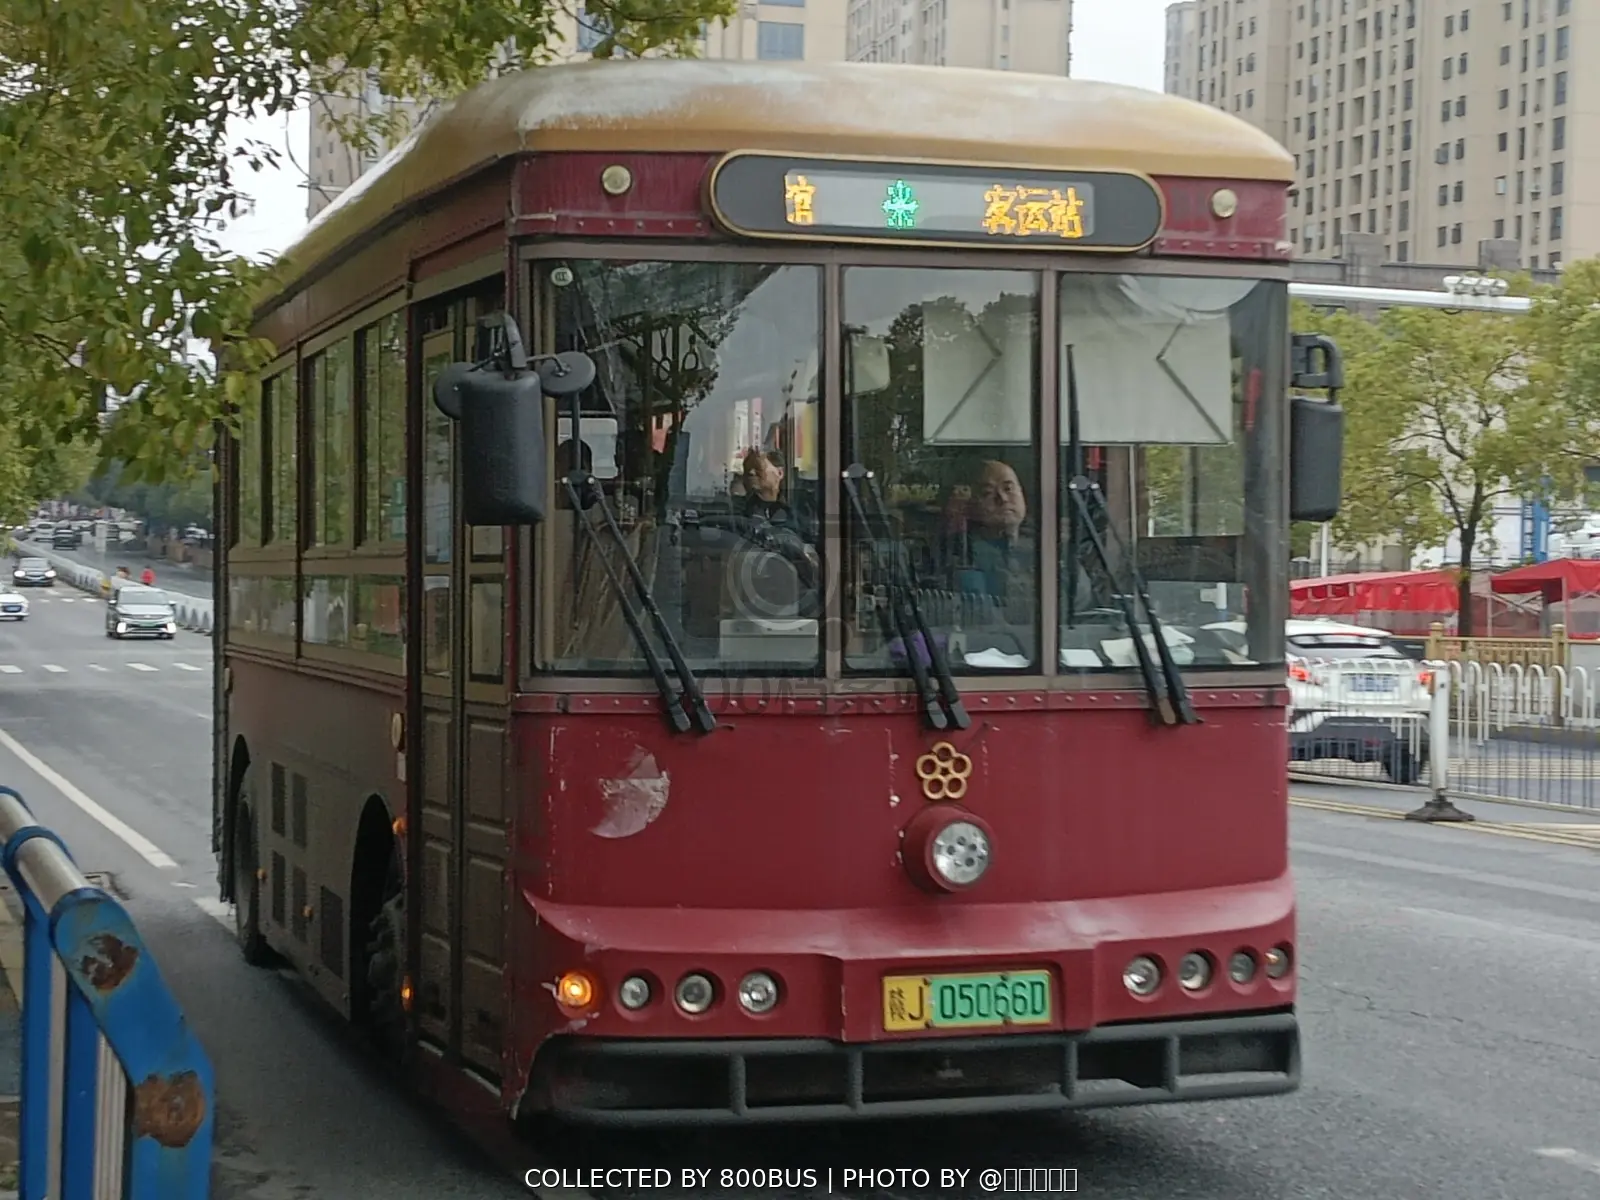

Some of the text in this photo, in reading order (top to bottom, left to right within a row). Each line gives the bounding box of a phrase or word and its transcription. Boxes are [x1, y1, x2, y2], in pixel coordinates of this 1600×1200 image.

[982, 184, 1085, 239] 客运站
[939, 981, 1047, 1020] 05066D
